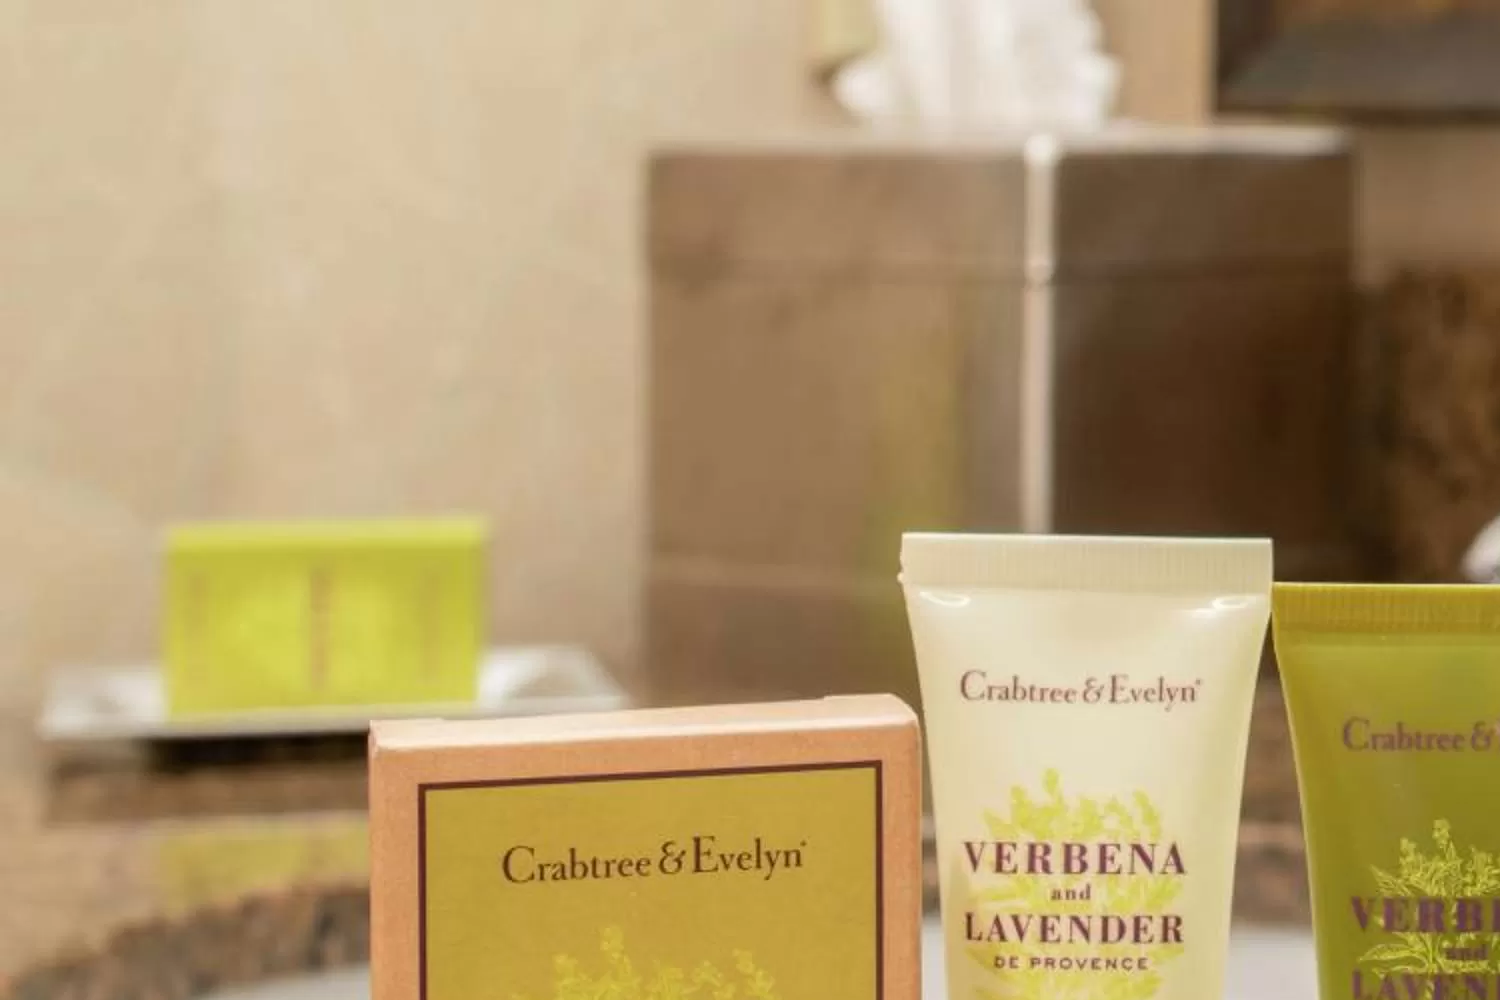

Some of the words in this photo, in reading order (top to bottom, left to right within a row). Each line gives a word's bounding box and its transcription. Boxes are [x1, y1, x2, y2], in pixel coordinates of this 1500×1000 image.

[959, 669, 1078, 701] Crabtree
[1082, 677, 1101, 703] &
[502, 844, 652, 884] Crabtree
[658, 841, 686, 876] &
[963, 840, 1188, 875] VERBENA
[1050, 883, 1092, 901] and
[964, 911, 1185, 945] LAVENDER
[993, 955, 1020, 970] DE
[1030, 956, 1149, 971] PROVENCE
